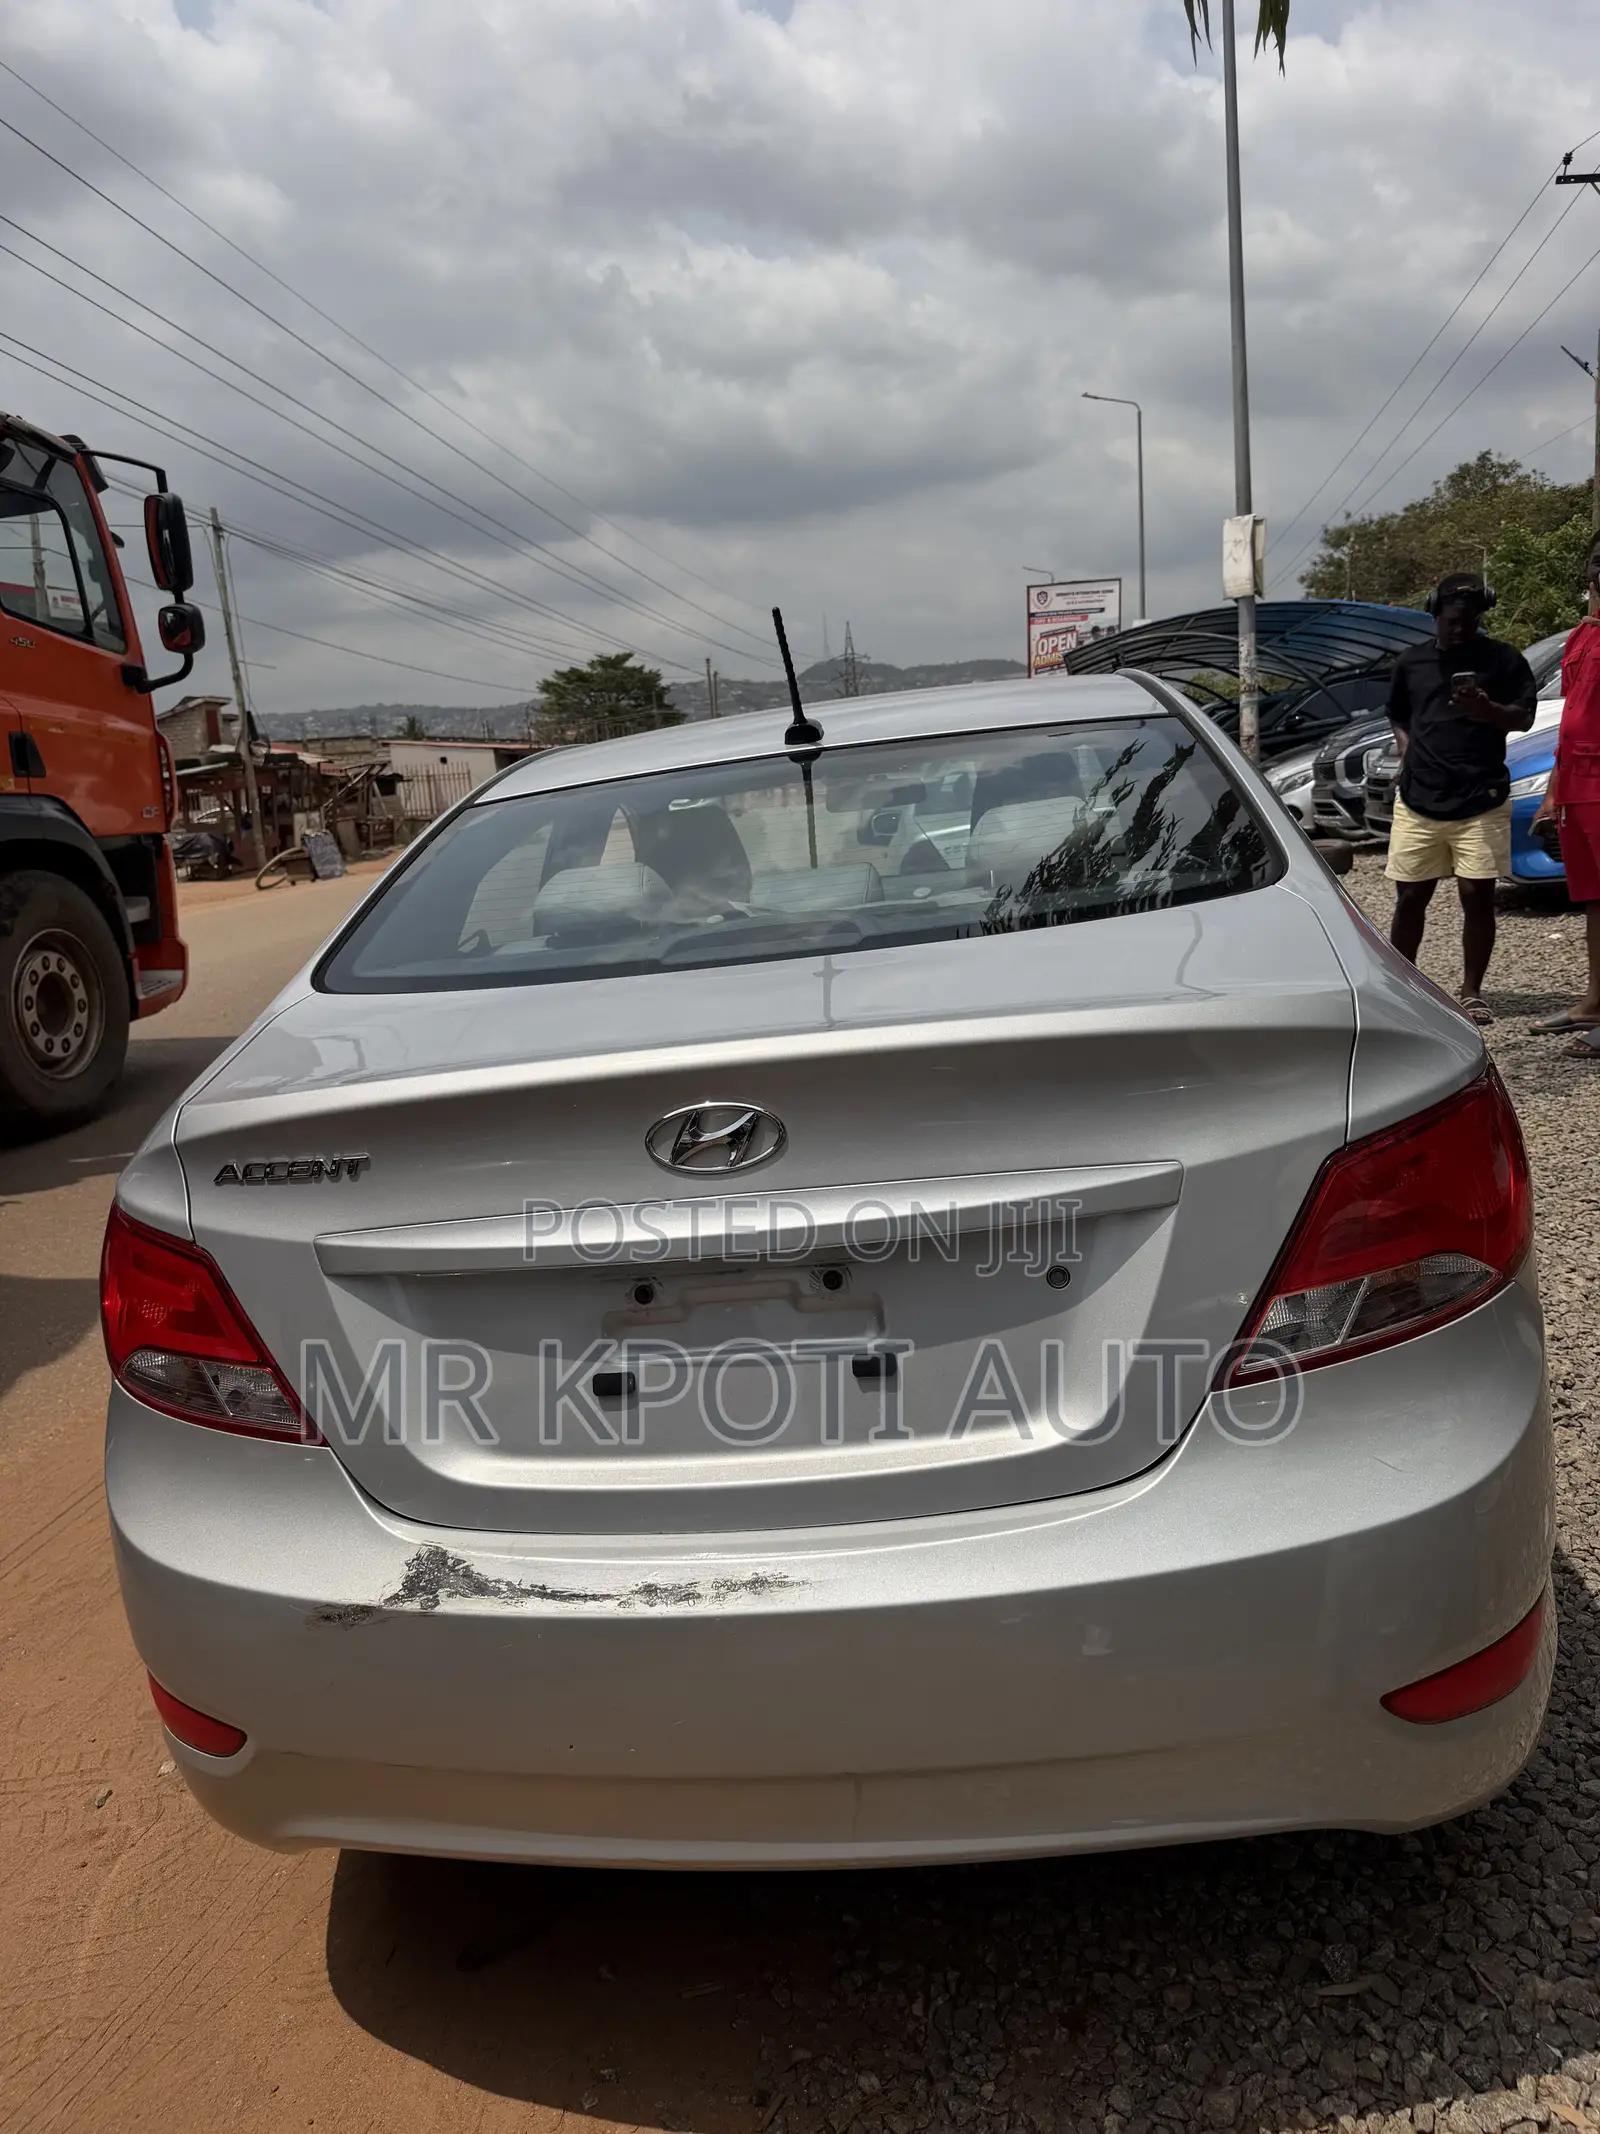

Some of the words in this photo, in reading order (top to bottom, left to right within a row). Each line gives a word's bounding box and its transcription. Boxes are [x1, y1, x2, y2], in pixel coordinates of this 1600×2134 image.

[10, 637, 37, 649] 450
[1037, 632, 1077, 656] OPEN
[213, 1152, 370, 1186] ACCENT
